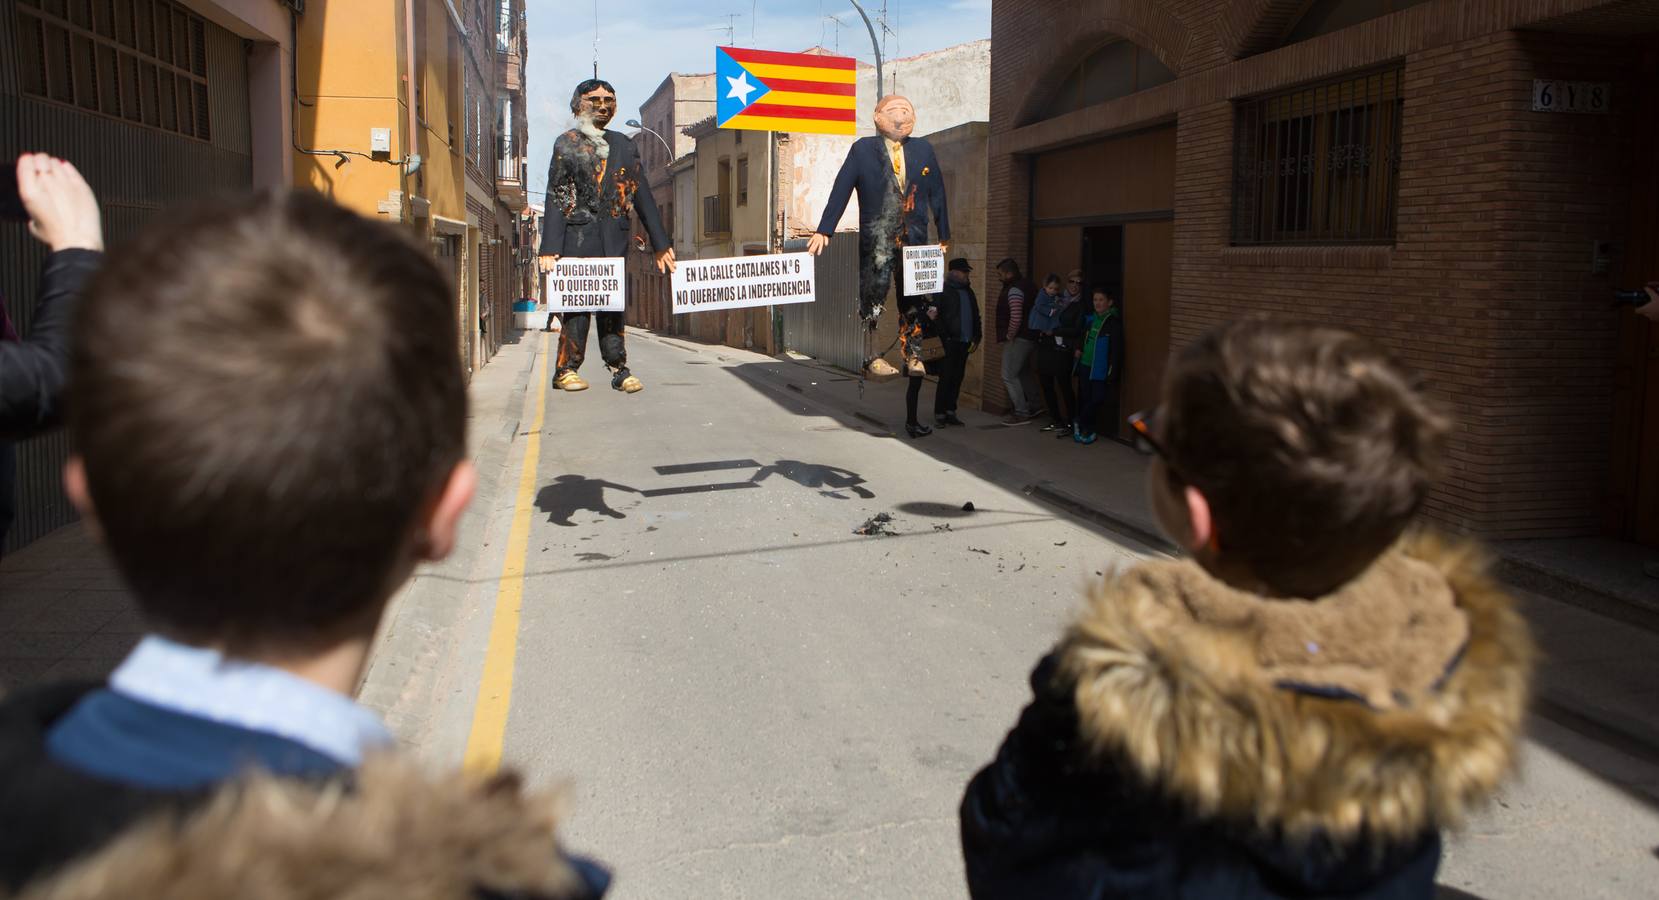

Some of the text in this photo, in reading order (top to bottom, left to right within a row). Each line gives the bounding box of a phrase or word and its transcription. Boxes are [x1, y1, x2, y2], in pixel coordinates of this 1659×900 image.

[1541, 84, 1603, 108] 6 Y 8
[556, 264, 615, 276] PUIGDEMONT
[686, 267, 696, 282] EN
[699, 266, 708, 281] LA
[710, 264, 734, 280] CALLE
[735, 260, 780, 278] CATALANES
[794, 259, 800, 274] 6
[914, 261, 919, 269] YO
[915, 271, 929, 281] QUIERO
[553, 279, 618, 292] YO QUIERO SER
[916, 281, 936, 290] PRESIDENT
[676, 280, 811, 306] NO QUEREMOS LA INDEPENDENCIA
[562, 294, 610, 306] PRESIDENT
